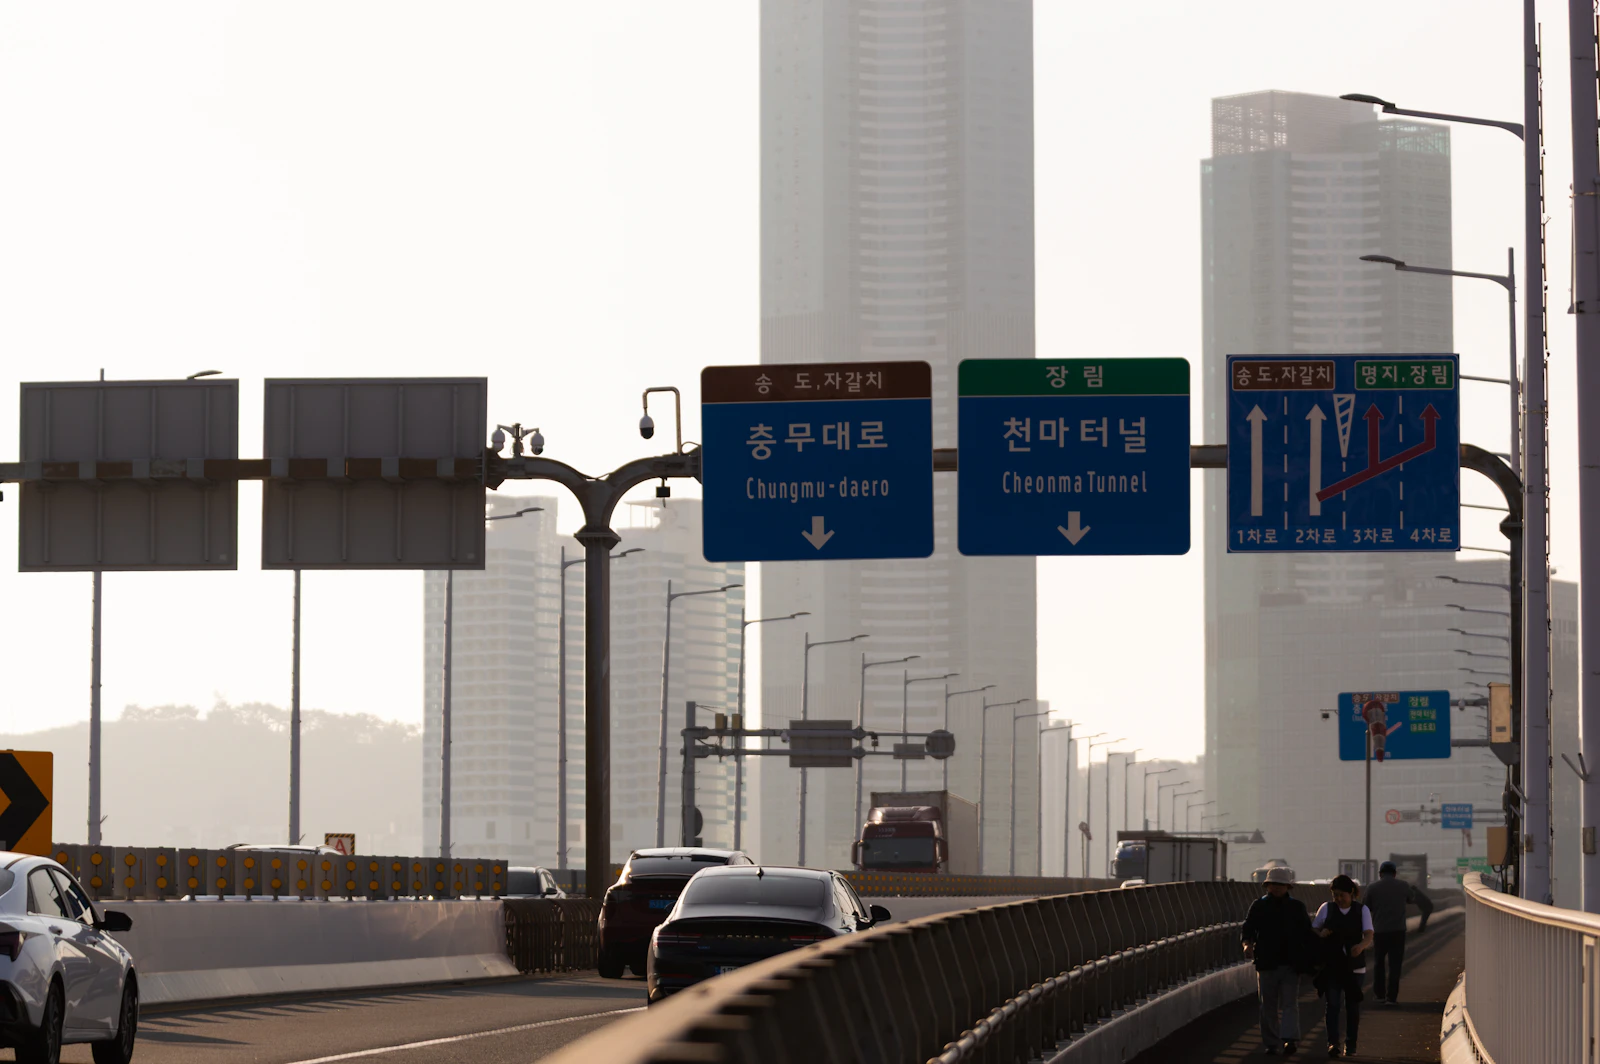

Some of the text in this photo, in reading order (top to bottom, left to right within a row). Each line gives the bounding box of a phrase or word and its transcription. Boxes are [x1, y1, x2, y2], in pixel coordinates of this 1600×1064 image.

[745, 420, 889, 461] 충무대로
[746, 476, 889, 504] Chungmu-daero
[1002, 470, 1147, 494] Cheonma Tunnel
[1237, 528, 1279, 545] 1차로
[1295, 527, 1337, 545] 2차로
[1352, 527, 1395, 544] 3차로
[1409, 527, 1453, 544] 4차로
